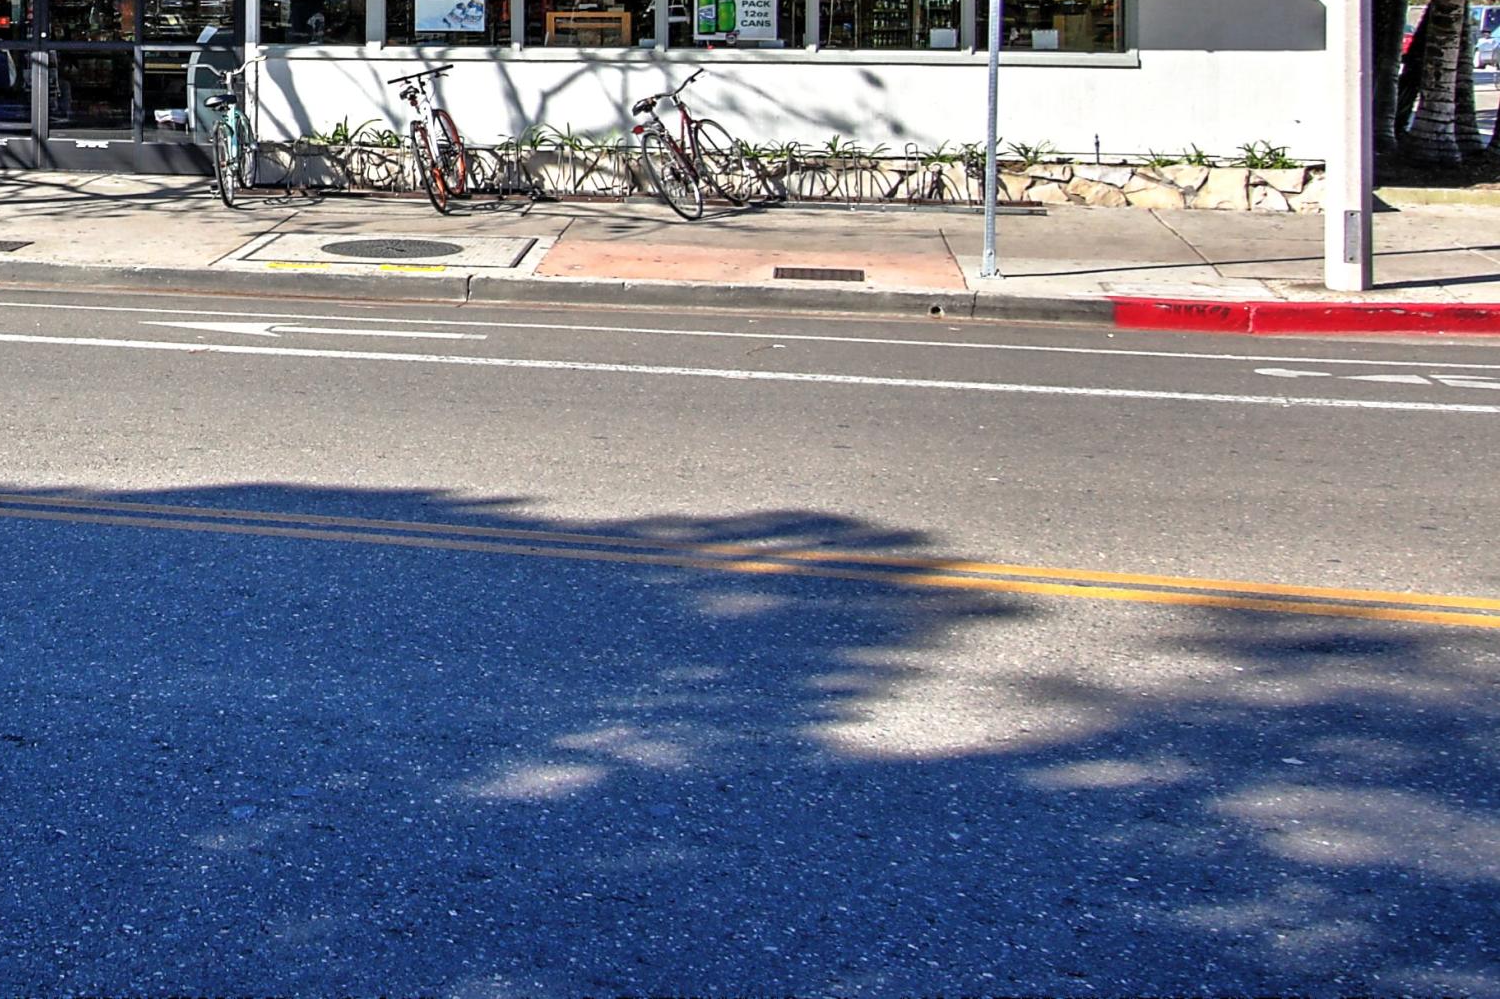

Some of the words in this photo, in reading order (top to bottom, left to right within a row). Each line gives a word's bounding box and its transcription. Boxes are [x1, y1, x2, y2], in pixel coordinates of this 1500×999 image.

[741, 0, 771, 8] PACK
[744, 10, 769, 18] 12oz
[741, 20, 771, 28] CANS
